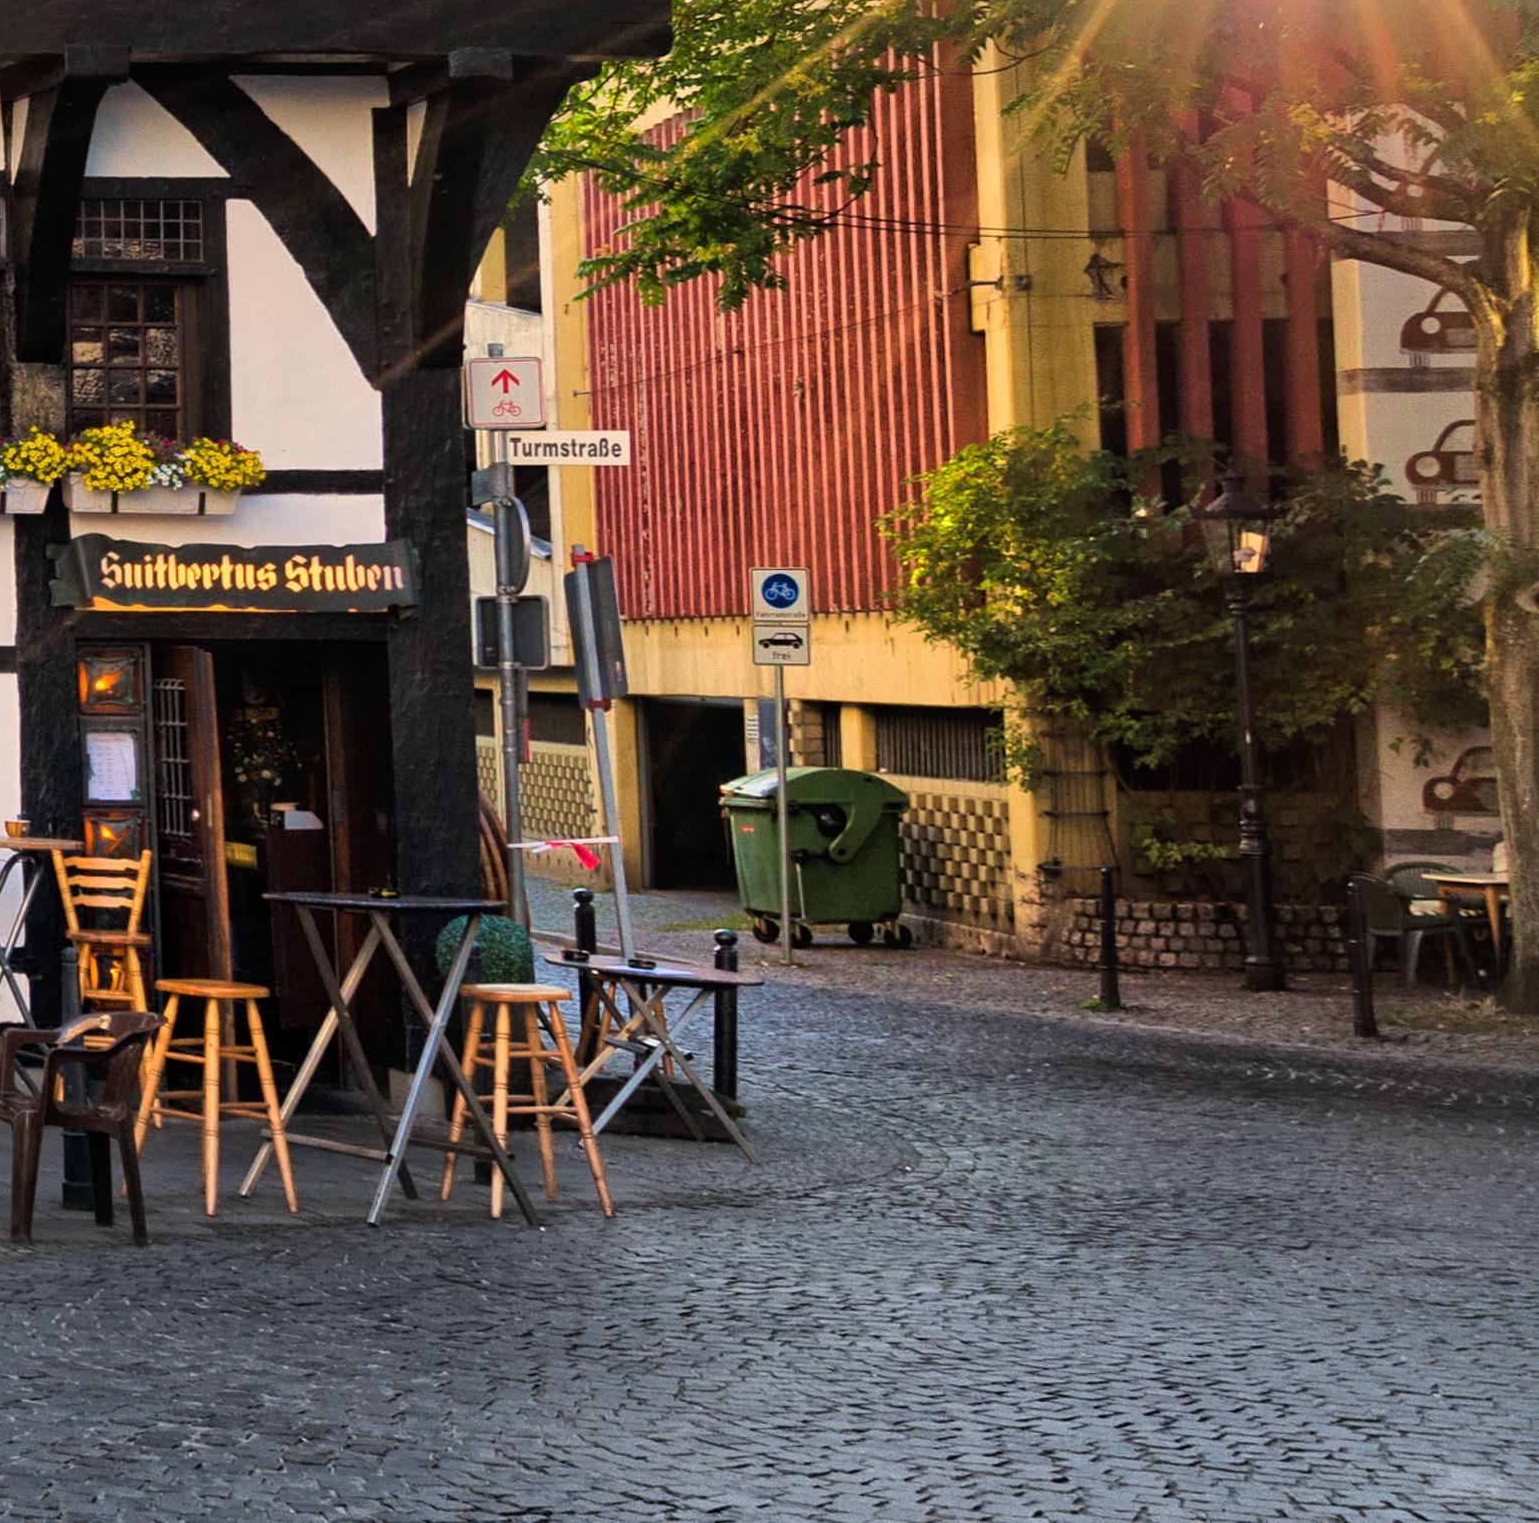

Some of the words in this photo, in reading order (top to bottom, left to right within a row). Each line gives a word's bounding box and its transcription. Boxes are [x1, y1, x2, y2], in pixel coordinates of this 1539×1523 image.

[509, 437, 622, 458] Turmstraße
[100, 551, 277, 592] Suitbertus
[284, 554, 404, 594] Stuben
[772, 651, 792, 660] frei
